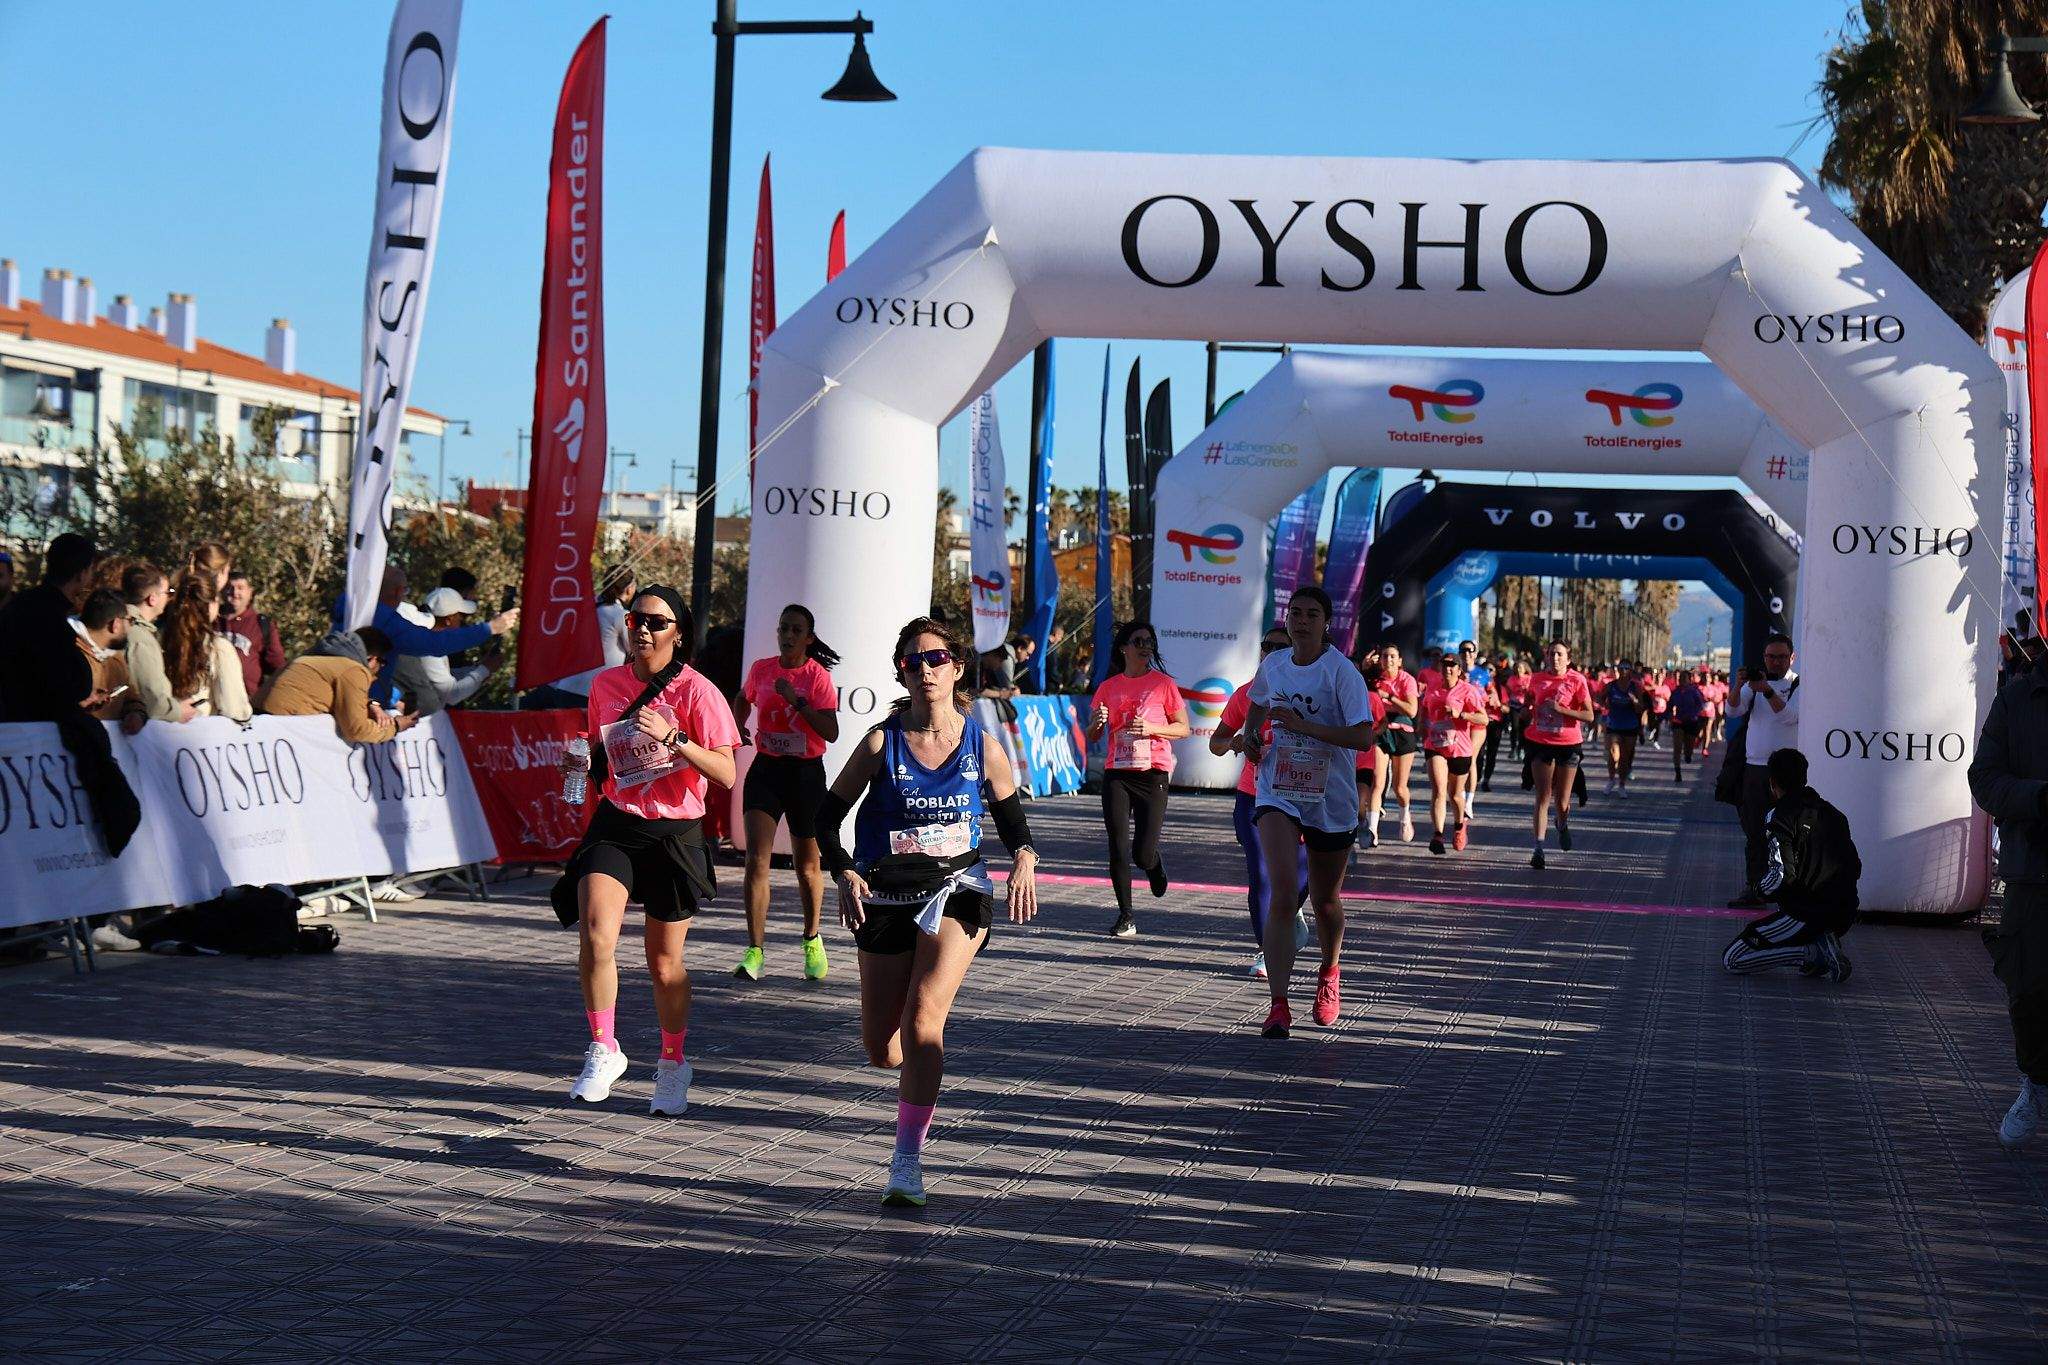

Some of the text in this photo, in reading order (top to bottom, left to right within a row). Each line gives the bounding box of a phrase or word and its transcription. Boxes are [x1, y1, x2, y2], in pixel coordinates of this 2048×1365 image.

[563, 112, 589, 387] Santander
[1121, 195, 1609, 297] OYSHO
[836, 297, 974, 330] OYSHO
[1754, 314, 1905, 344] OYSHO
[1387, 430, 1484, 446] TotalEnergies
[1583, 436, 1682, 451] TotalEnergies
[765, 487, 891, 520] OYSHO
[1484, 508, 1686, 531] VOLVO
[1833, 525, 1973, 557] OYSHO
[1165, 571, 1242, 586] TotalEnergies
[1161, 629, 1238, 641] totalenergies.es
[632, 742, 659, 758] 016
[1825, 729, 1966, 762] OYSHO
[175, 738, 304, 818] OYSHO
[1291, 770, 1312, 780] 016
[906, 794, 970, 809] POBLATS
